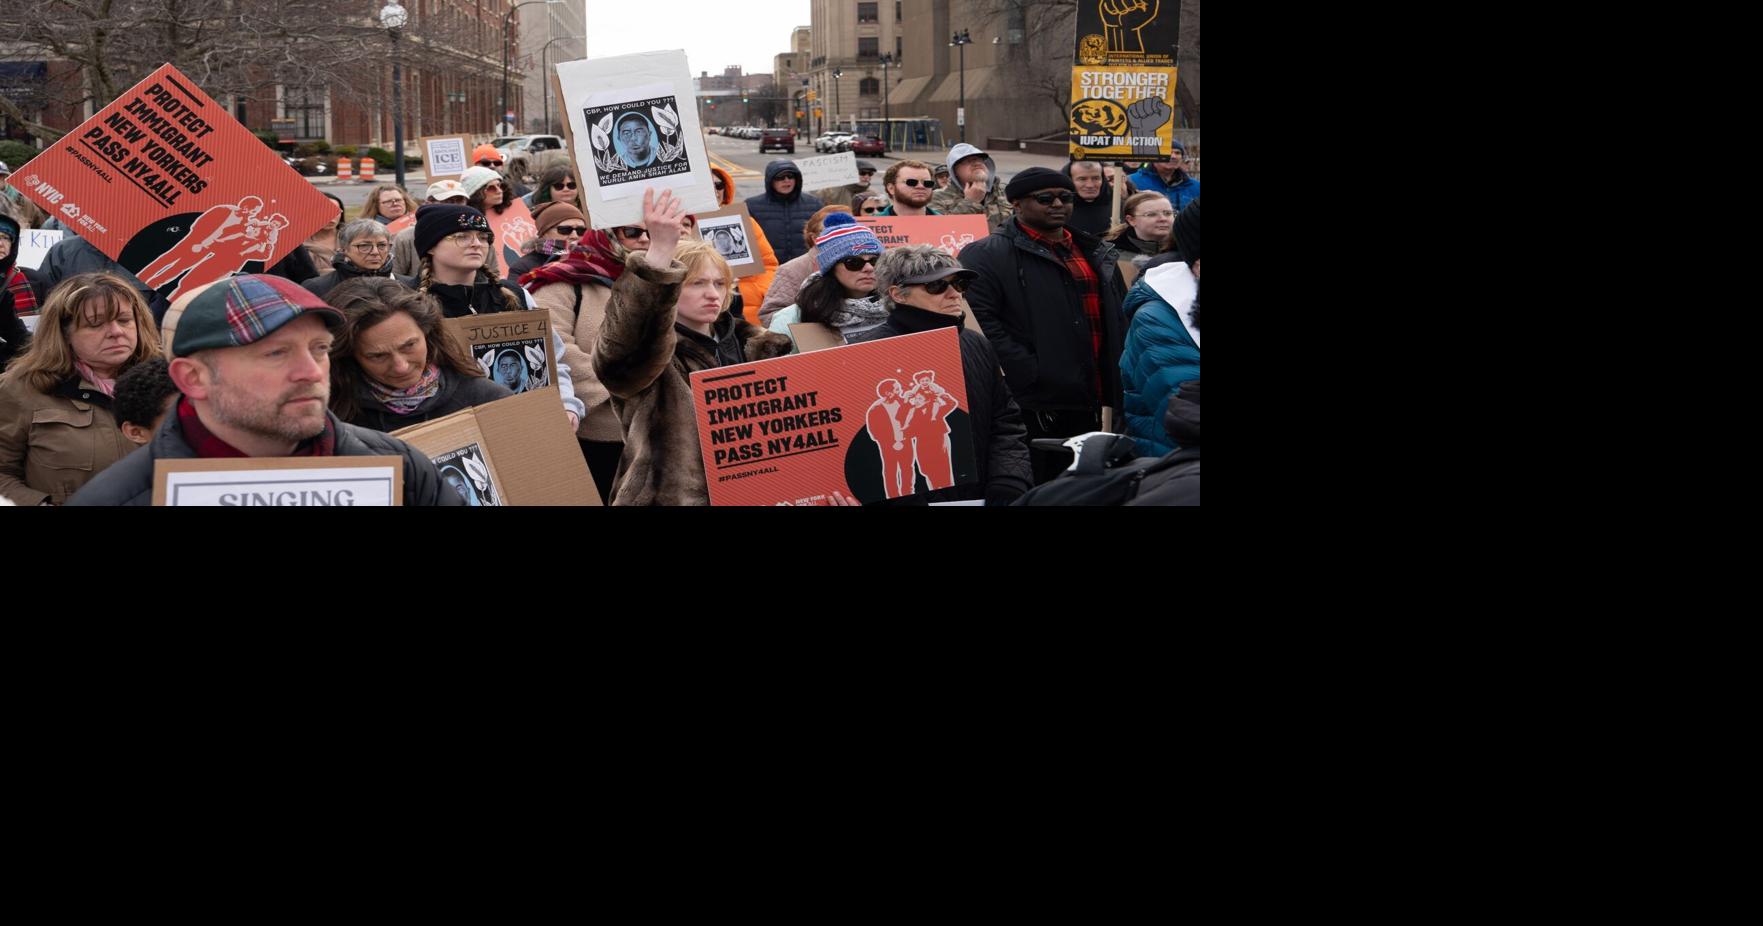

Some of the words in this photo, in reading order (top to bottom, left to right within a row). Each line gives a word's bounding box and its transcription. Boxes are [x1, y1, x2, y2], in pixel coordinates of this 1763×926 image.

[1081, 71, 1169, 86] STRONGER
[1080, 85, 1167, 100] TOGETHER
[144, 83, 214, 139] PROTECT
[621, 101, 645, 110] COULD
[123, 97, 214, 168] IMMIGRANT
[1080, 136, 1112, 146] IUPAT
[1113, 136, 1125, 146] IN
[1127, 136, 1163, 146] ACTION
[104, 112, 147, 144] NEW
[141, 138, 208, 194] YORKERS
[435, 152, 460, 164] ICE
[803, 156, 848, 167] FASCISM
[65, 146, 113, 183] #PASSNY4ALL
[83, 126, 130, 163] PASS
[123, 157, 182, 206] NY4ALL
[612, 169, 641, 179] DEMAND
[643, 164, 672, 173] JUSTICE
[602, 177, 626, 185] NURUL
[668, 166, 687, 174] ALAM
[34, 182, 64, 204] NYIC
[869, 225, 893, 234] TECT
[468, 323, 529, 340] JUSTICE
[537, 320, 547, 336] 4
[704, 376, 788, 405] PROTECT
[707, 391, 818, 426] IMMIGRANT
[711, 423, 753, 445] NEW
[758, 407, 842, 436] YORKERS
[437, 453, 456, 464] COULD
[456, 448, 468, 456] YOU
[714, 442, 763, 465] PASS
[767, 429, 838, 455] NY4ALL
[718, 466, 780, 482] #PASSNY4ALL
[218, 489, 355, 507] SINGING
